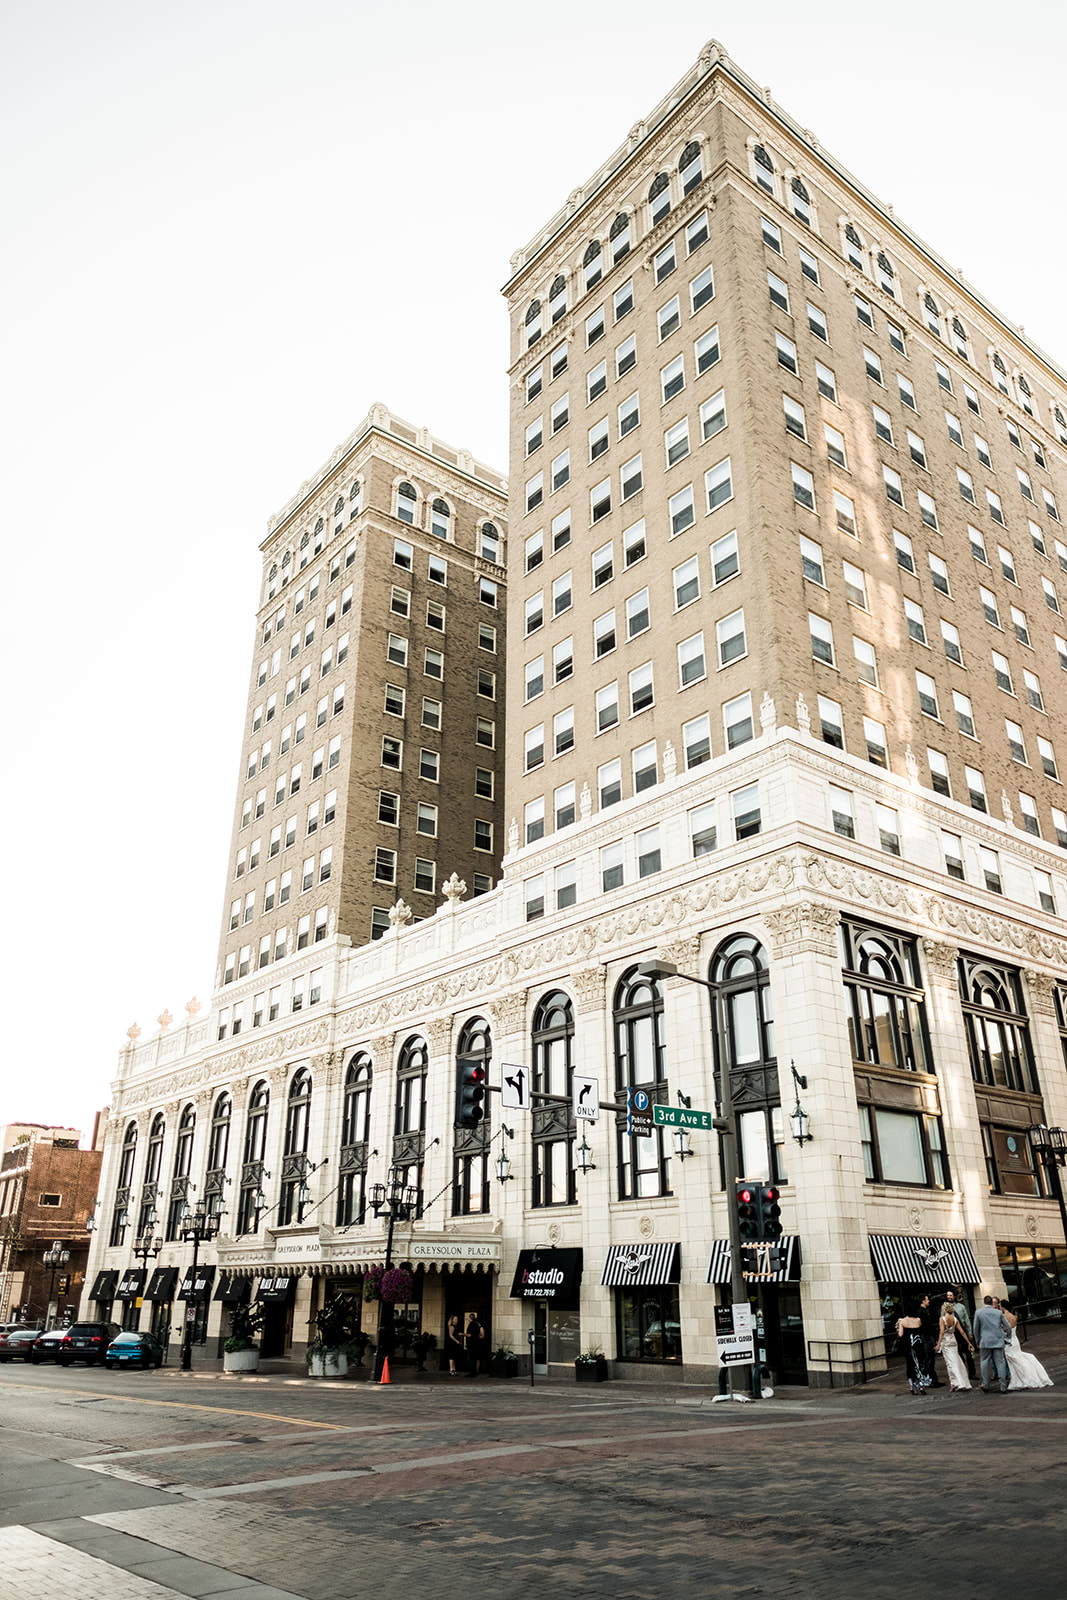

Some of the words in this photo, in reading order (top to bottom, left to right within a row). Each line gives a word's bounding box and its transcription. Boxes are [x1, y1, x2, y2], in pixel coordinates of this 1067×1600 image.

[577, 1106, 596, 1116] ONLY
[631, 1115, 647, 1123] Public
[659, 1110, 675, 1122] 3rd
[680, 1115, 698, 1125] Ave
[702, 1116, 709, 1126] E
[631, 1124, 650, 1134] Parking
[414, 1246, 463, 1256] GREYSOLON
[467, 1247, 492, 1256] PLAZA
[521, 1268, 564, 1285] bstudio
[717, 1337, 737, 1345] SIDEWALK
[738, 1335, 753, 1343] CLOSED
